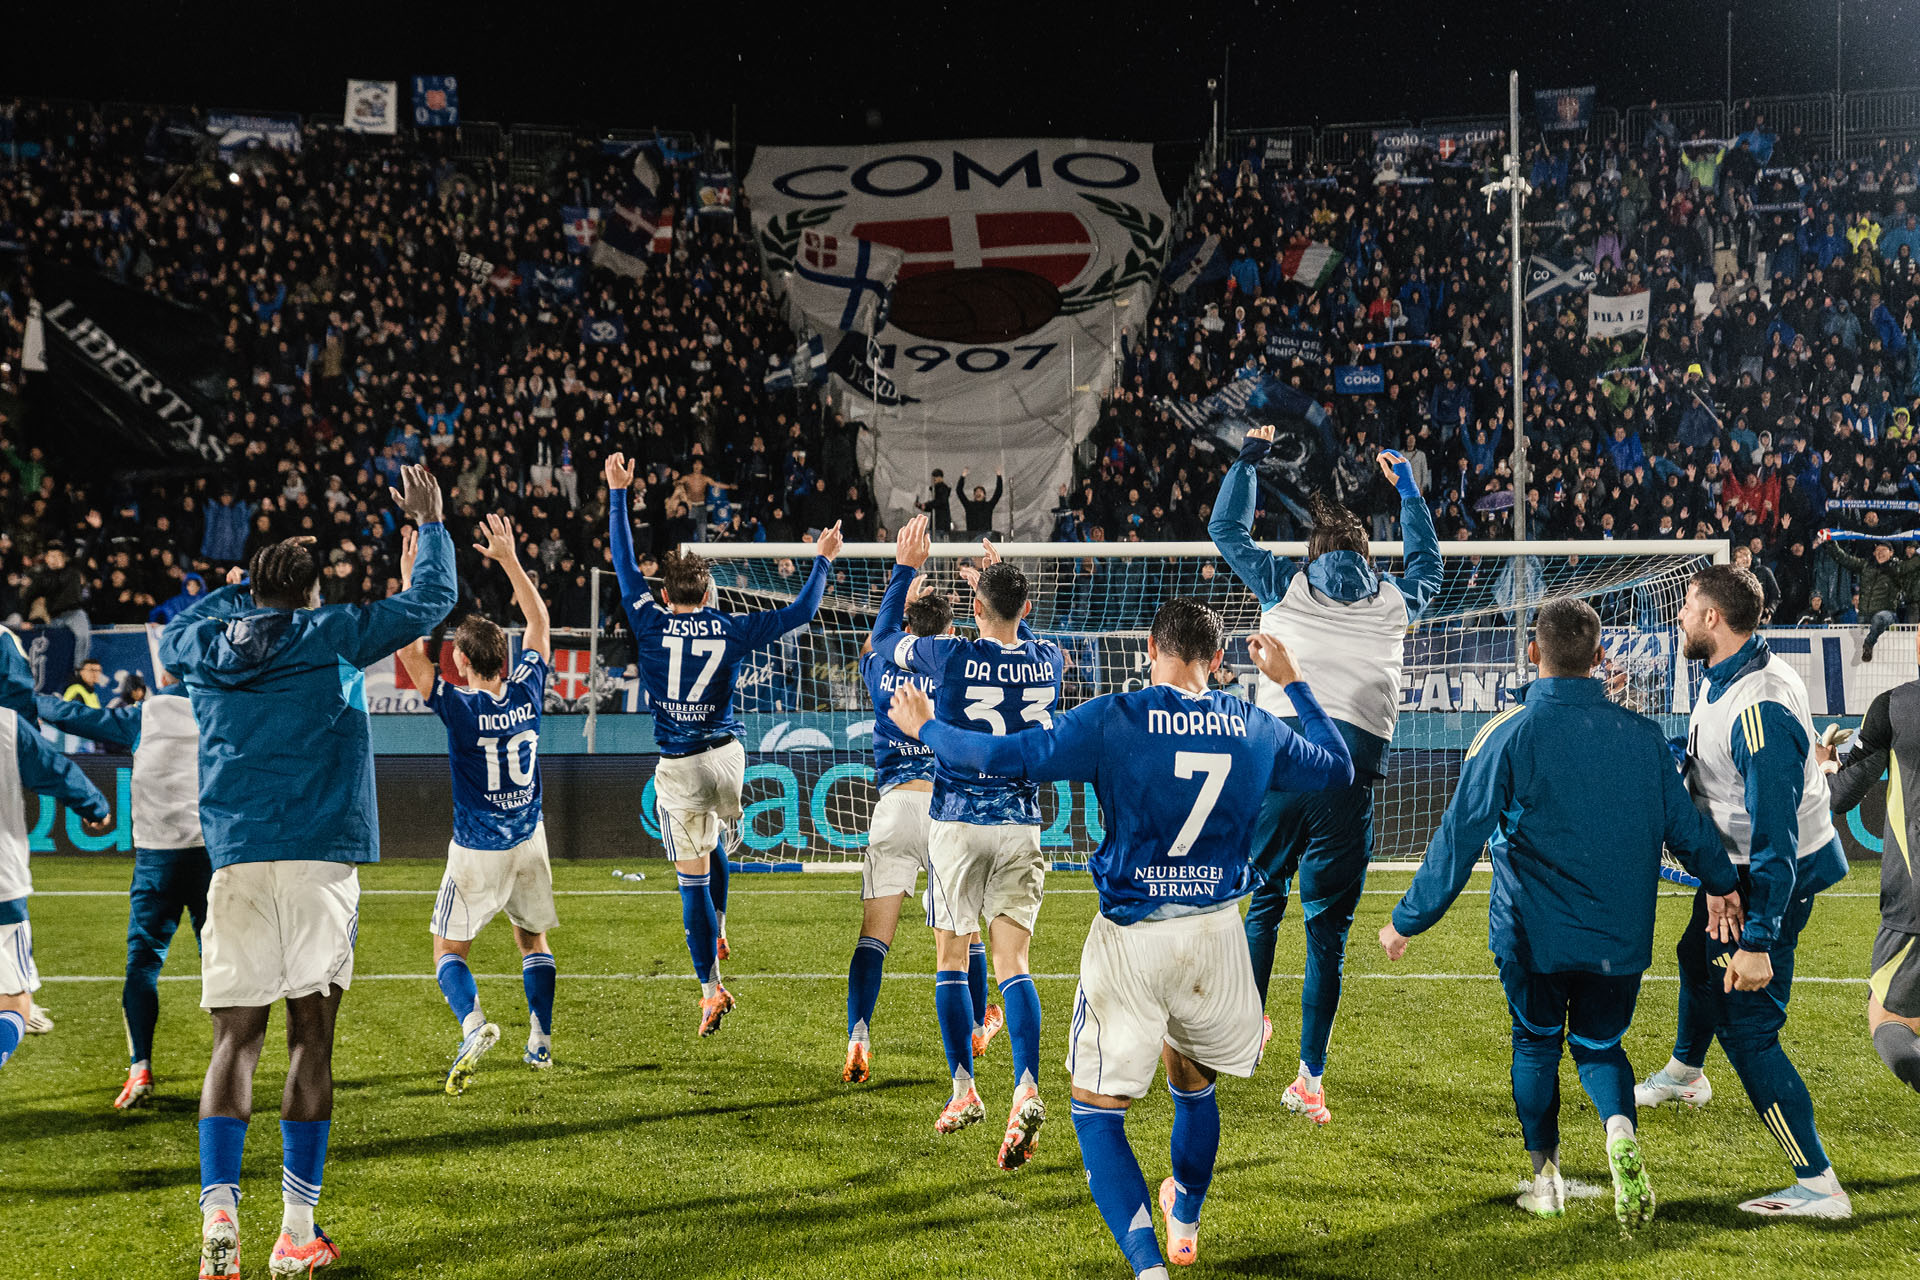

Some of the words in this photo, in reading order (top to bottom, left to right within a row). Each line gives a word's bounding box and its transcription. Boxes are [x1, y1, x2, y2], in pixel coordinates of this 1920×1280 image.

[772, 149, 1141, 200] COMO
[1594, 311, 1624, 322] FILA
[1630, 309, 1644, 321] 12
[879, 342, 1058, 373] 1907
[45, 299, 232, 462] LIBERTAS
[1344, 375, 1380, 385] COMO
[711, 620, 727, 635] R.
[662, 636, 726, 702] 17
[964, 660, 991, 681] DA
[998, 662, 1055, 683] CUNHA
[479, 713, 509, 731] NICO
[510, 703, 535, 727] PAZ
[963, 686, 1055, 736] 33
[1149, 710, 1247, 737] MORATA
[477, 729, 539, 792] 10
[1167, 751, 1232, 857] 7
[1134, 866, 1224, 881] NEUBERGER
[1149, 882, 1215, 897] BERMAN
